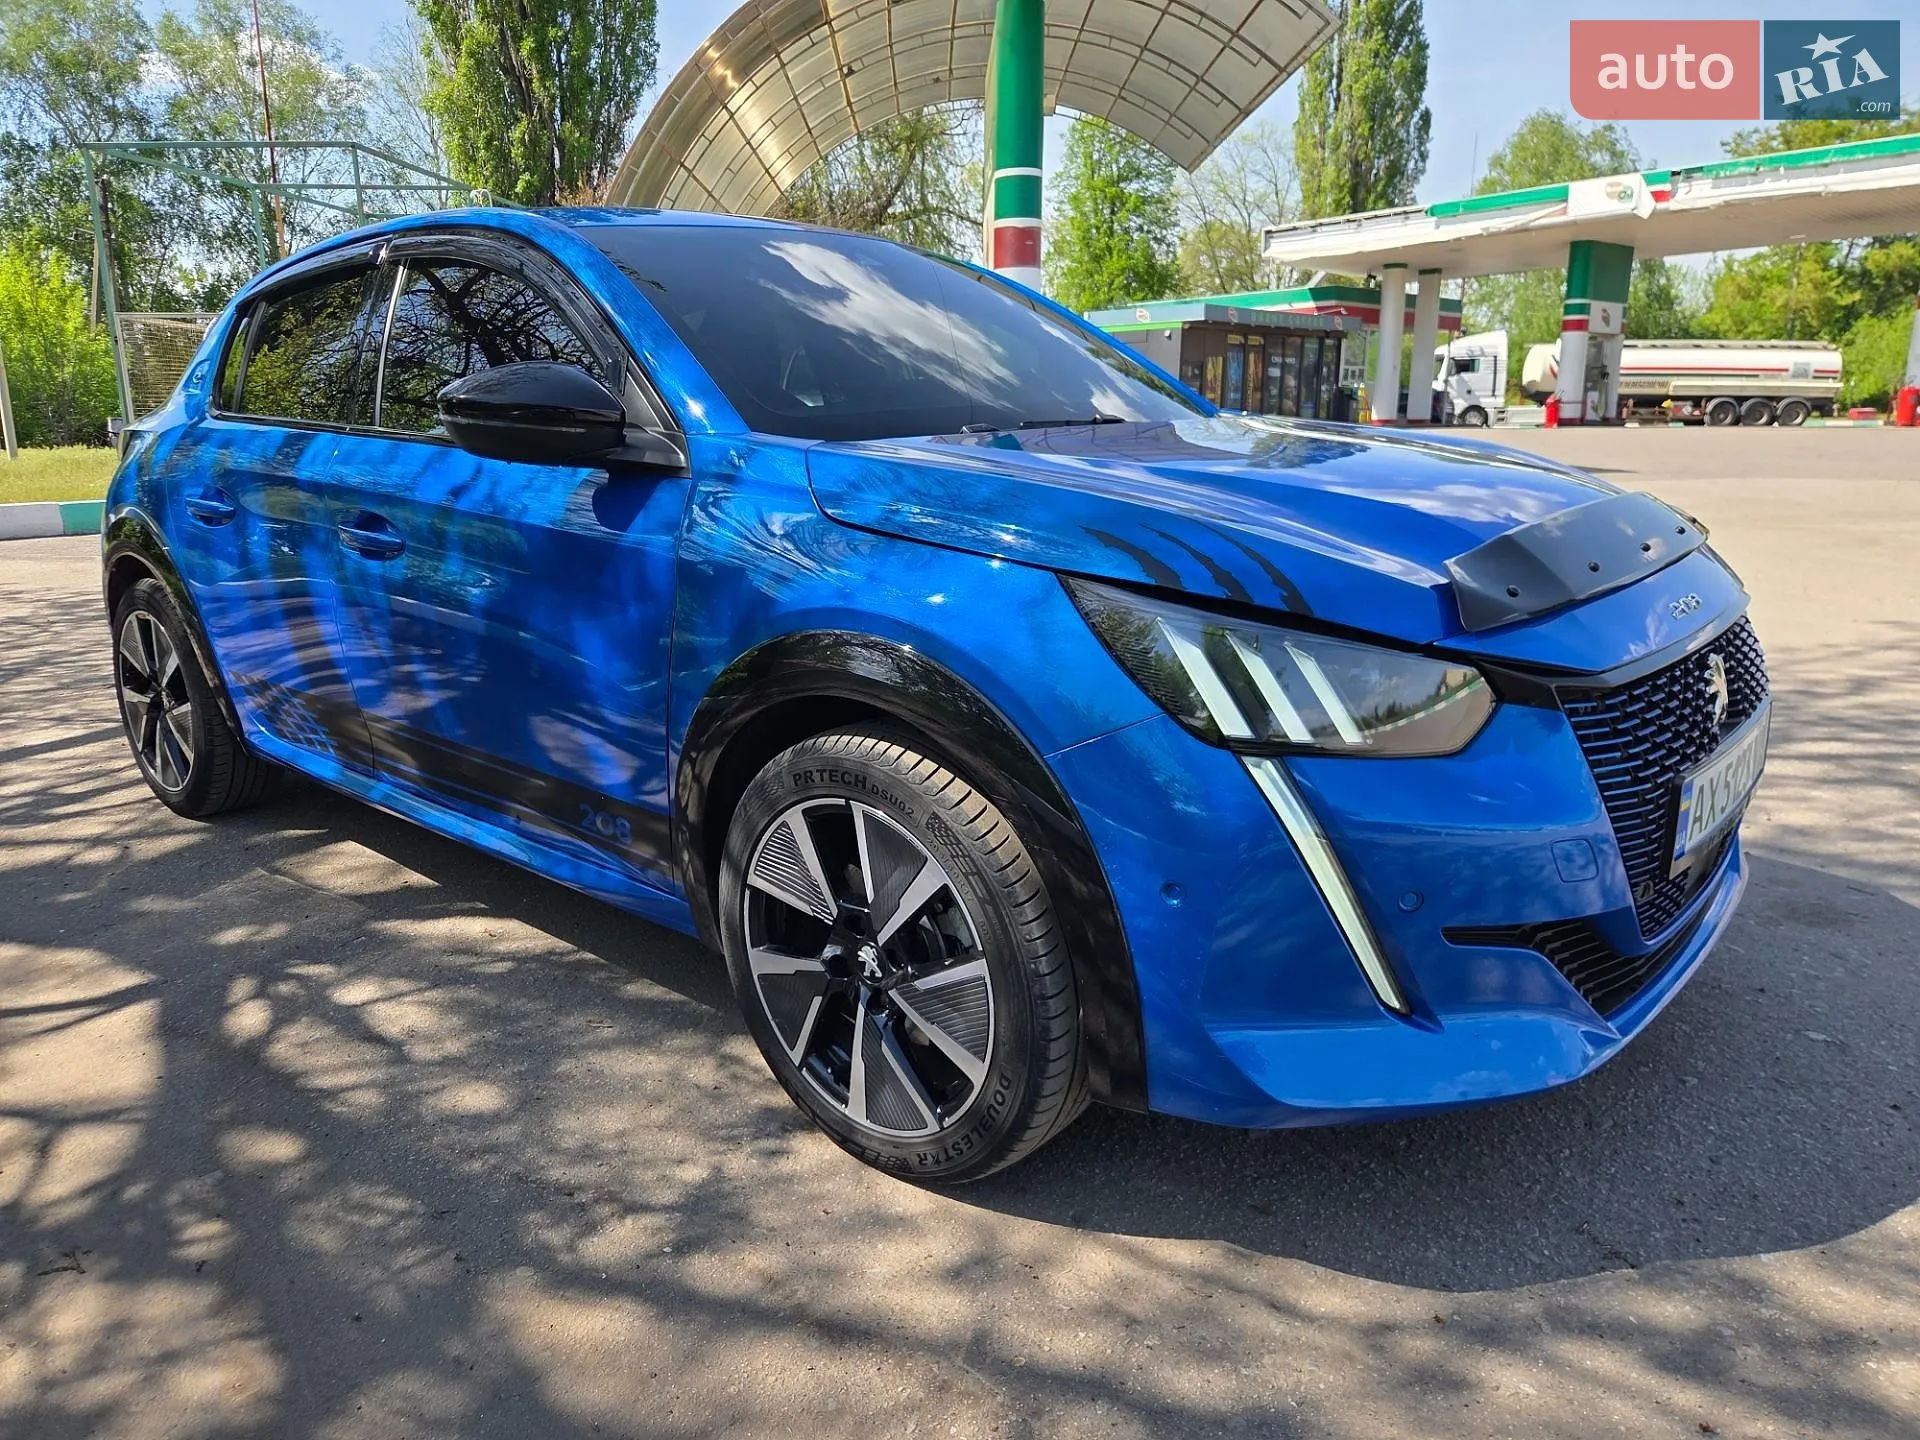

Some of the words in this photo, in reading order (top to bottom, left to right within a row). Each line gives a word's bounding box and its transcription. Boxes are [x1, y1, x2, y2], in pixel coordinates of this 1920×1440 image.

[792, 769, 867, 789] PRTECH
[871, 785, 915, 818] DSU02
[1689, 770, 1721, 841] AX
[579, 803, 633, 844] 208
